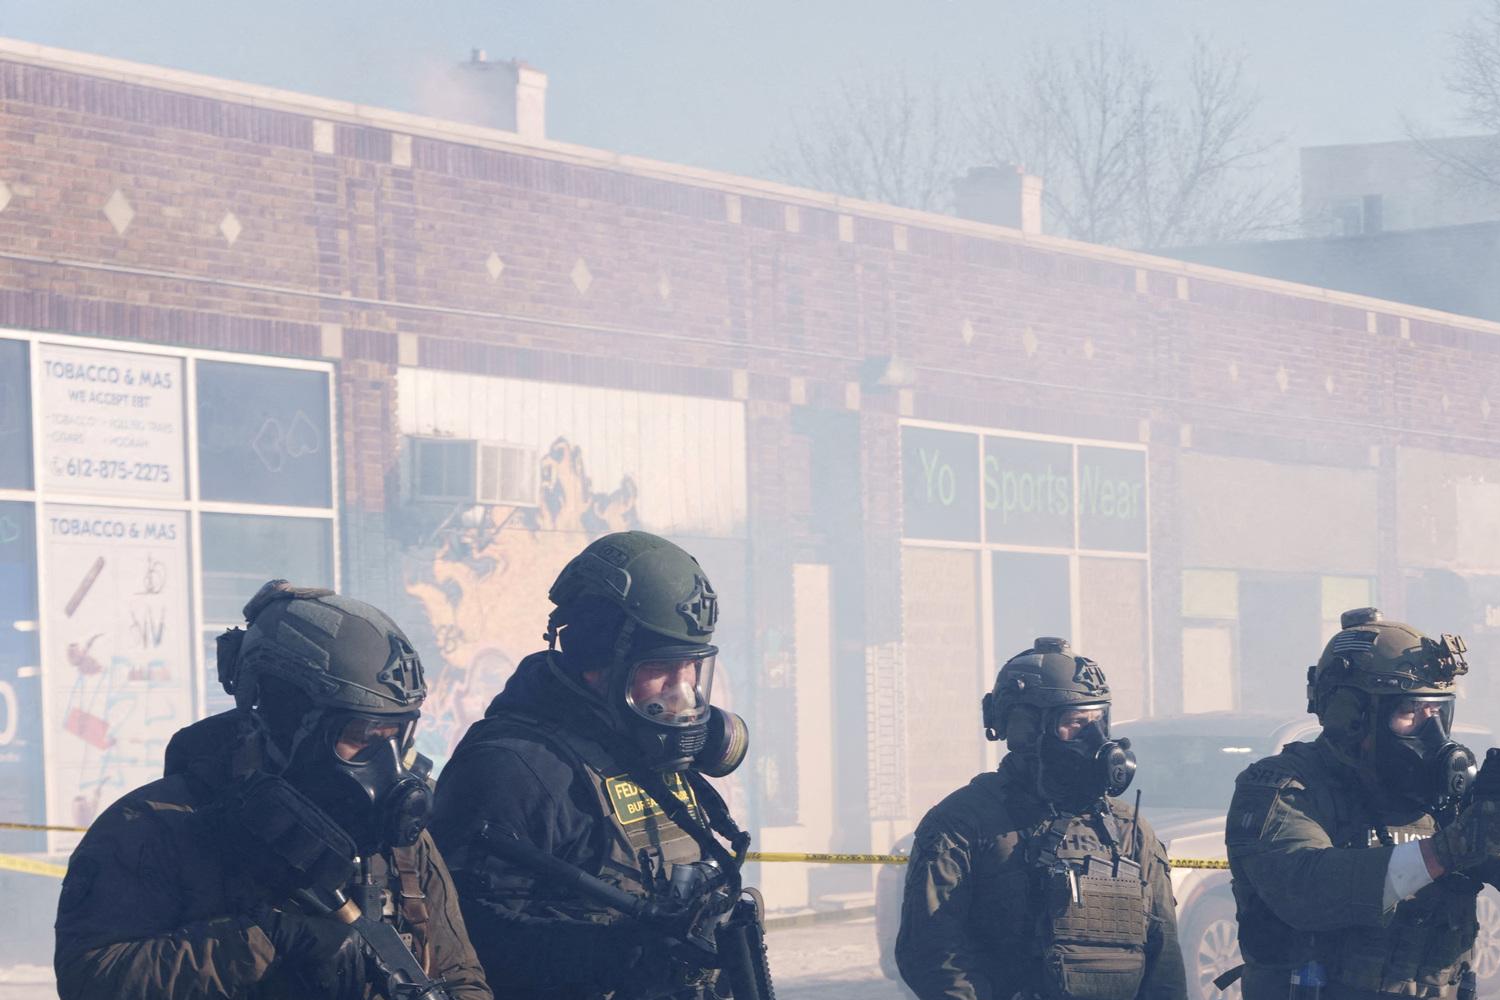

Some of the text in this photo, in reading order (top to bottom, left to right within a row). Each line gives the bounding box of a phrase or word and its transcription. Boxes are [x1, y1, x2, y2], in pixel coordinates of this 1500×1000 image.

[44, 360, 172, 389] TOBACCO & MAS
[67, 457, 170, 483] 612-875-2275
[917, 447, 1143, 525] Yo Sports Wear
[50, 518, 177, 540] TOBACCO & MAS
